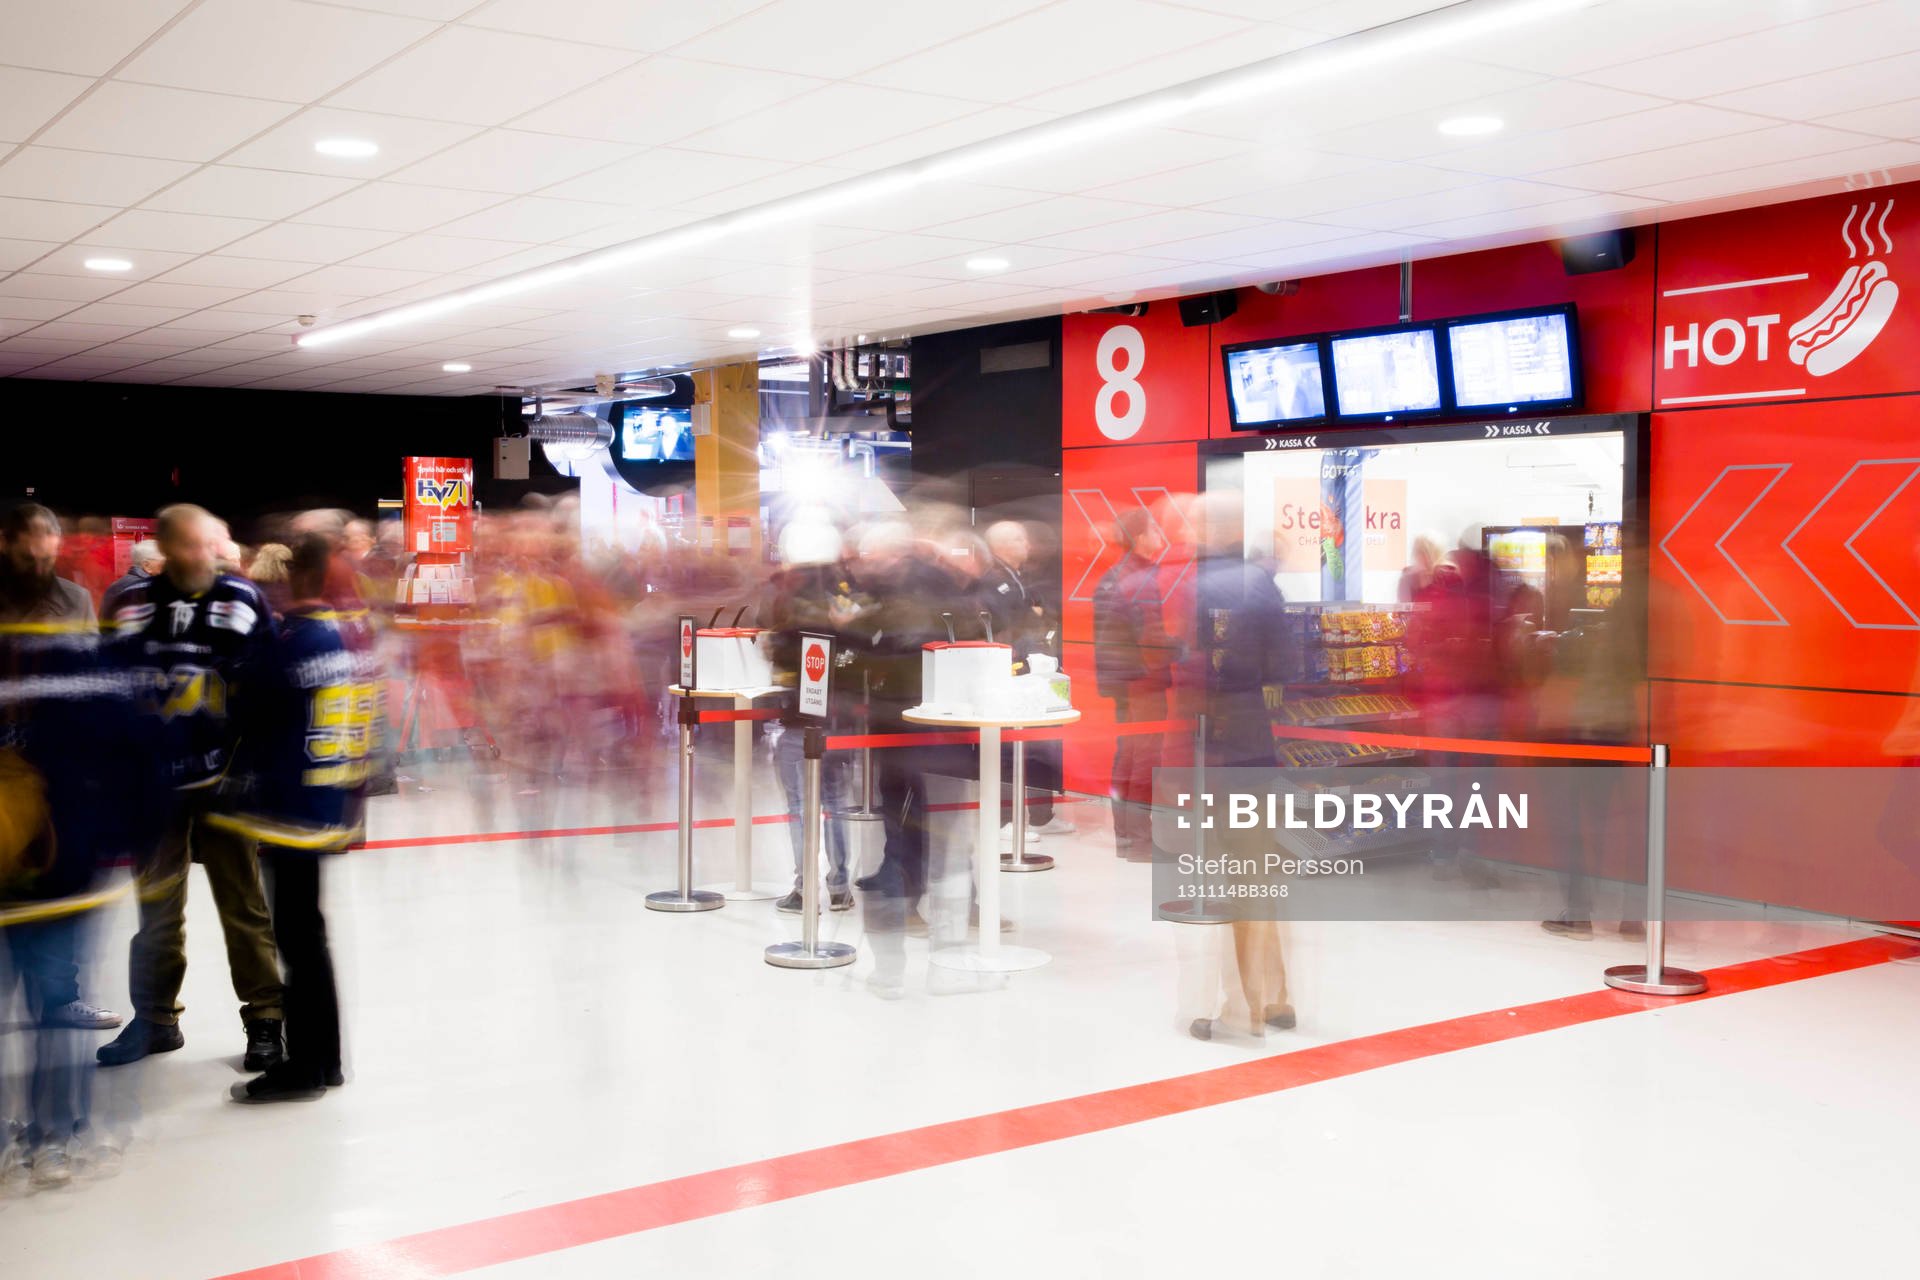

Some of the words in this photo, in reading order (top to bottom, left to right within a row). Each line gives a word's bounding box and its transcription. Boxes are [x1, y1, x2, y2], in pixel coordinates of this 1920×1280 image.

[1663, 313, 1781, 370] HOT
[1095, 324, 1147, 441] 8
[1503, 424, 1532, 436] KASSA
[1279, 438, 1303, 448] KASSA
[806, 656, 825, 670] STOP
